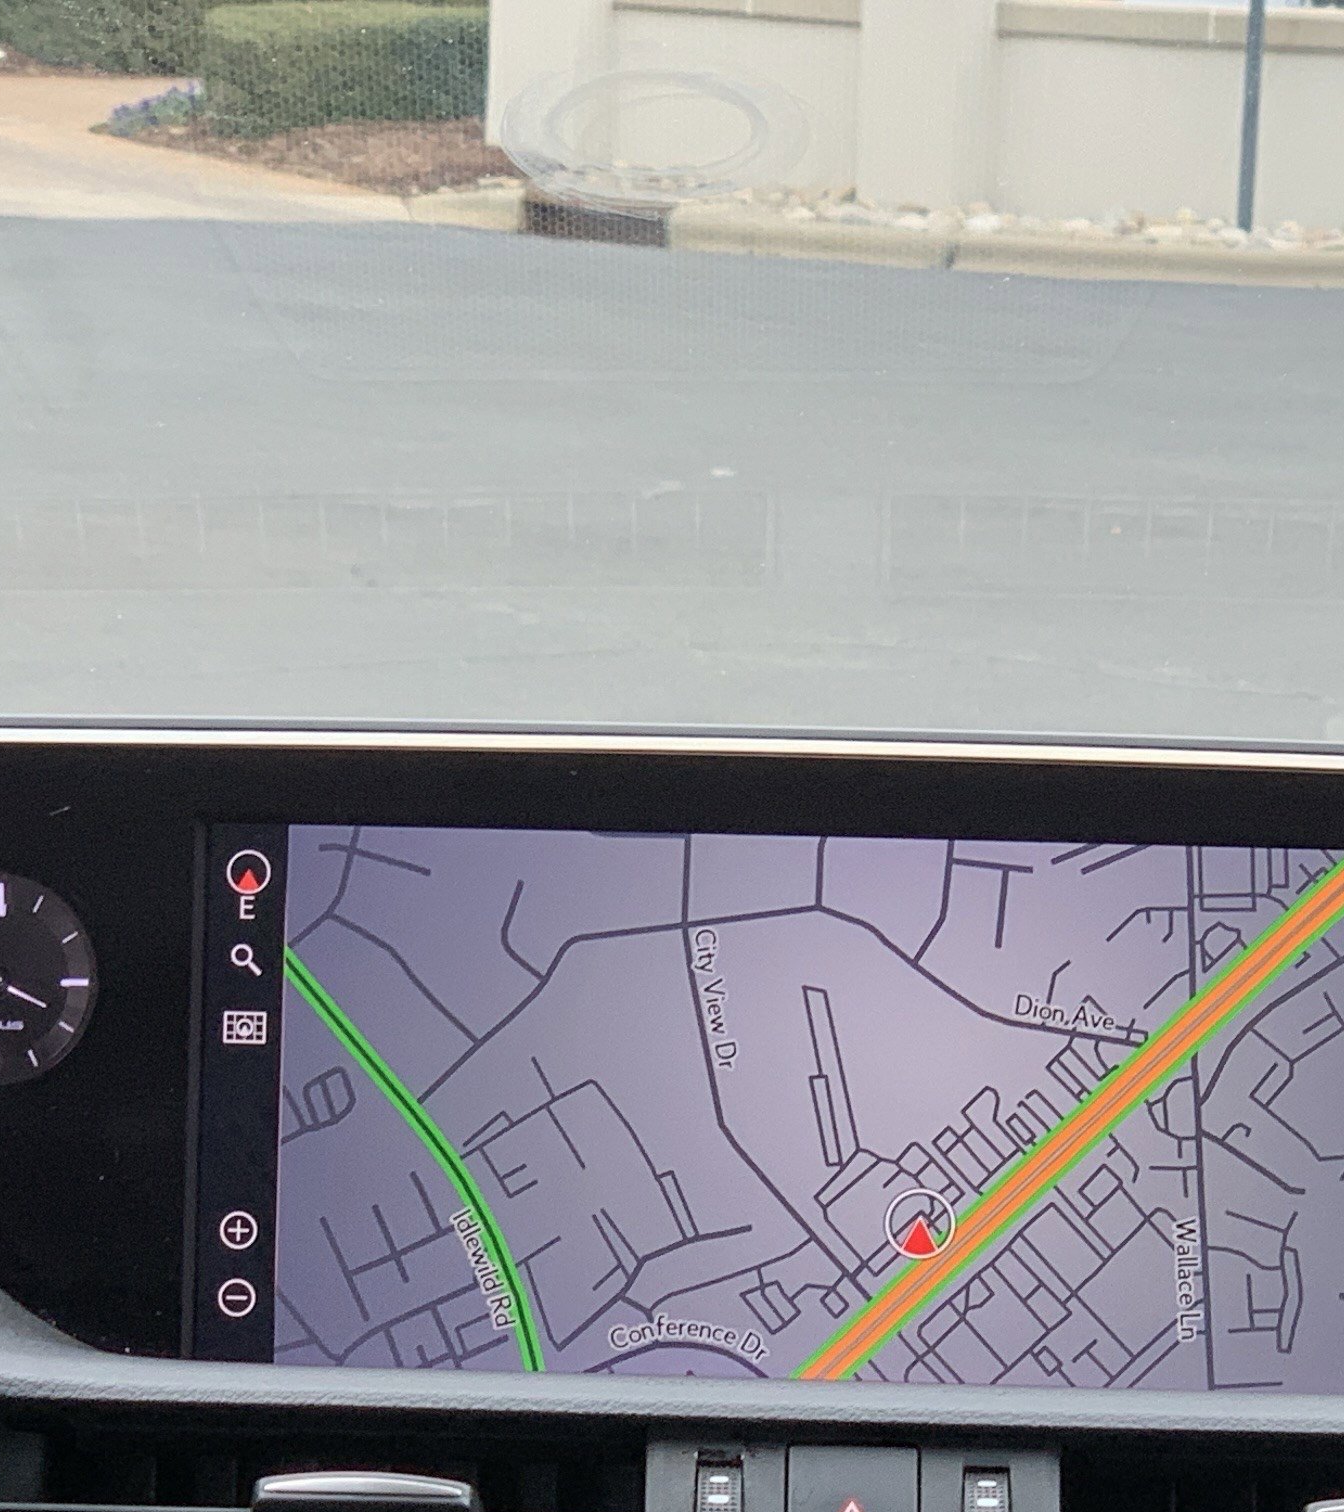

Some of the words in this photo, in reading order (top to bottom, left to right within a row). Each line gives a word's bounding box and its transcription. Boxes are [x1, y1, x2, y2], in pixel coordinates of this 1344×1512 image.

[240, 895, 256, 920] E
[695, 929, 717, 973] City
[704, 978, 725, 1034] View
[1013, 995, 1065, 1023] Dion
[1071, 1011, 1115, 1032] Ave
[714, 1041, 737, 1068] Dr
[453, 1209, 504, 1291] Idlewild
[490, 1295, 516, 1327] Rd
[1173, 1219, 1198, 1303] Wallace
[610, 1316, 737, 1348] Conference
[740, 1332, 767, 1361] Dr
[1177, 1310, 1202, 1341] Ln
